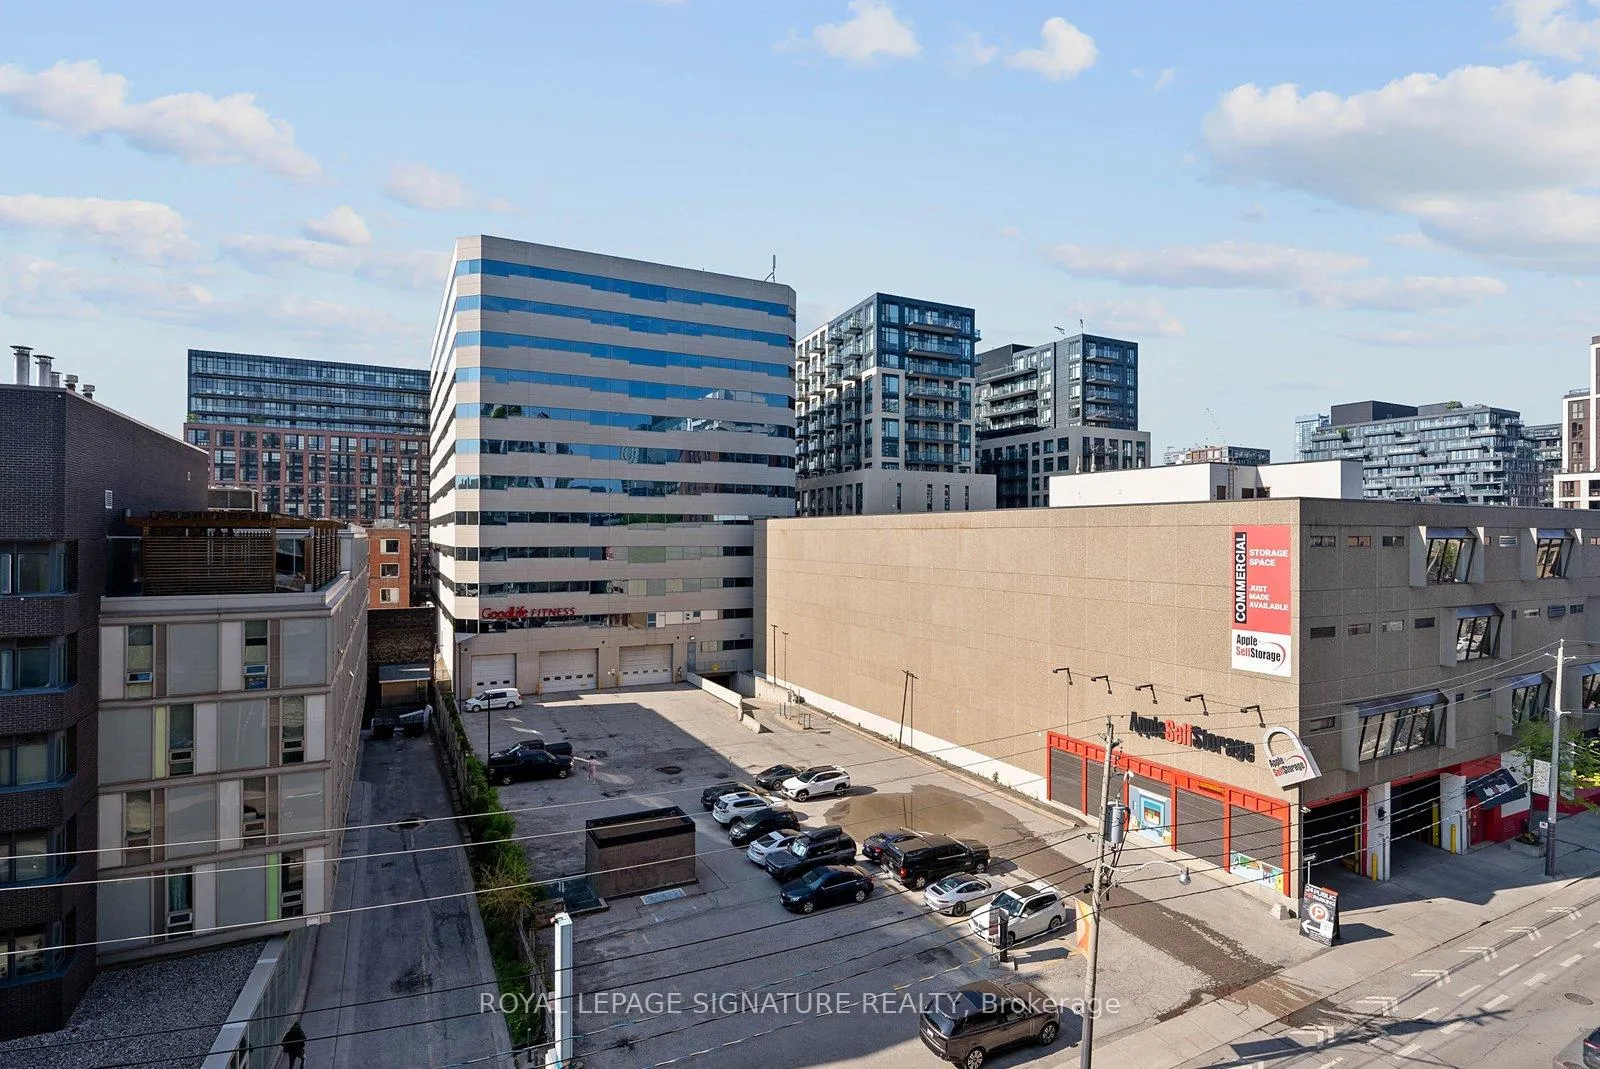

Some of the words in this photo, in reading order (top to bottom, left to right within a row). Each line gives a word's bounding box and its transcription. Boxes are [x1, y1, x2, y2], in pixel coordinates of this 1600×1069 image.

[1249, 549, 1289, 558] STORAGE
[1249, 558, 1276, 567] SPACE
[1235, 533, 1246, 622] COMMERCIAL
[1249, 585, 1268, 593] JUST
[1249, 593, 1270, 601] MADE
[1249, 601, 1289, 611] AVAILABLE
[531, 607, 576, 617] FITNESS
[1236, 634, 1258, 647] Apple
[1313, 889, 1336, 901] PUBLIC
